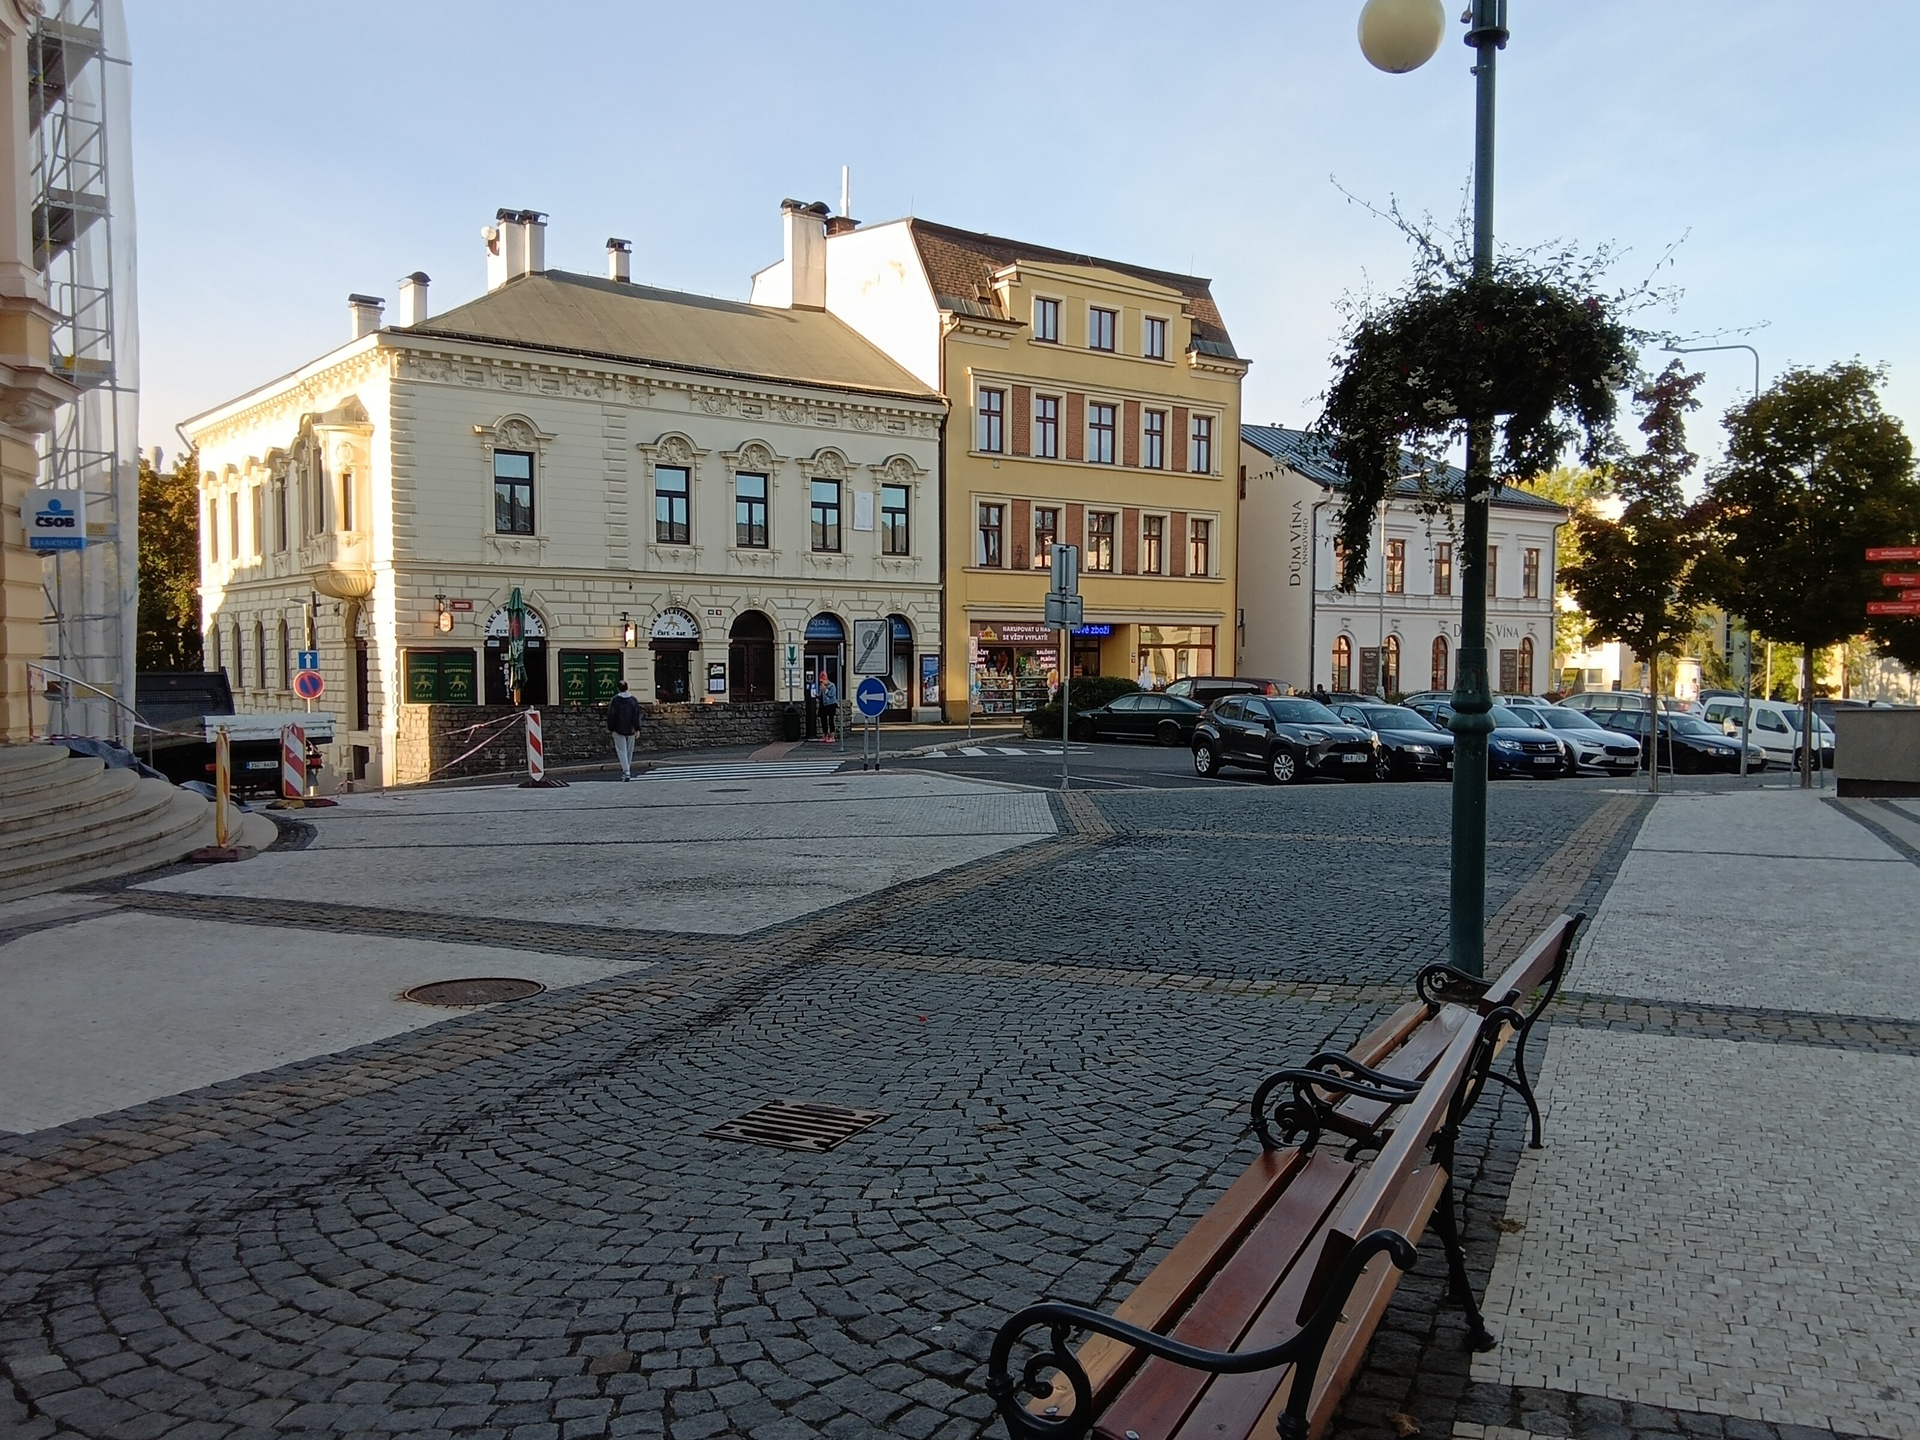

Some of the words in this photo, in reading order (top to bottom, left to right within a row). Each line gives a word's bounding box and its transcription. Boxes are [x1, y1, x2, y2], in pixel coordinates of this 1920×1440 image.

[35, 516, 75, 528] ČSOB
[1289, 500, 1302, 542] VÍNA
[33, 540, 80, 548] BANKOMAT
[1289, 546, 1301, 586] DŮM
[1090, 625, 1110, 635] zboží
[1495, 624, 1519, 638] VÍNA
